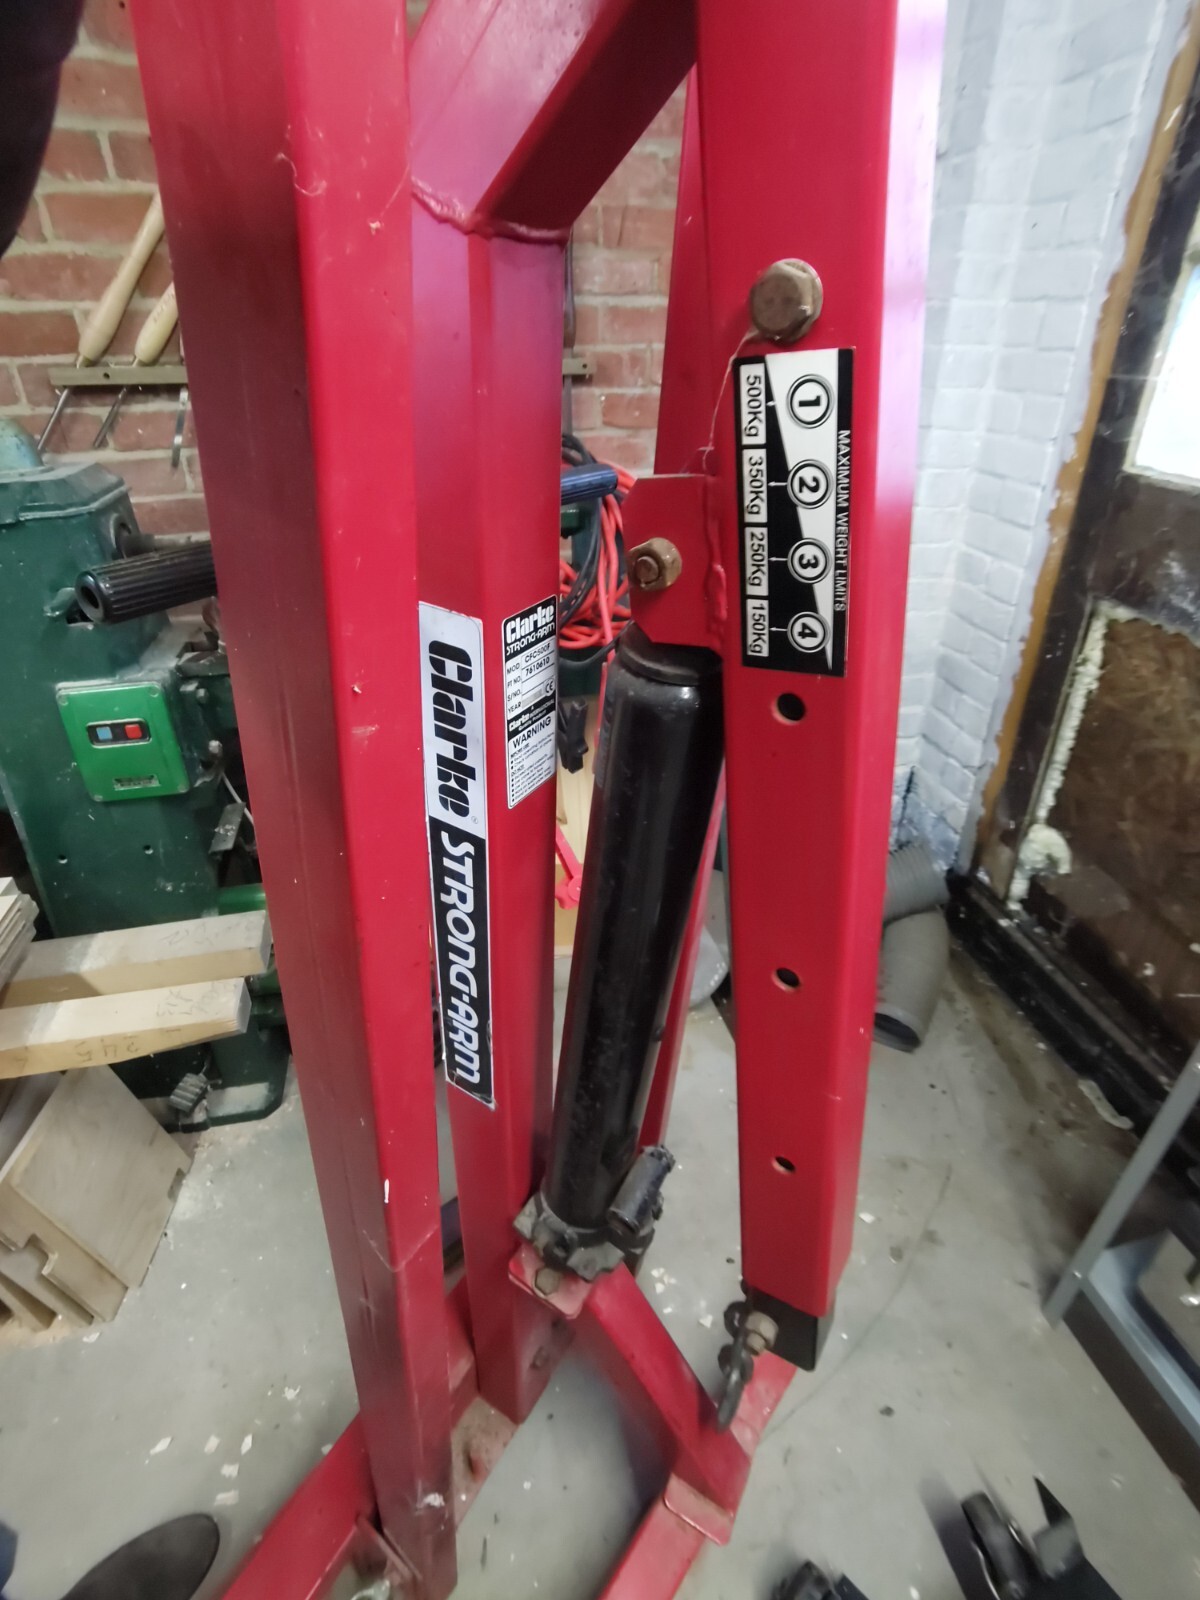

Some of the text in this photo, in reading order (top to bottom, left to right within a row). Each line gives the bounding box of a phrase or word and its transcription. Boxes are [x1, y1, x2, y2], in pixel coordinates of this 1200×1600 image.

[744, 374, 763, 438] 500Kg
[798, 395, 821, 408] 1
[746, 456, 764, 516] 350Kg
[798, 475, 820, 494] 2
[834, 430, 851, 612] MAXIMUM WEIGHT LIMITS
[748, 531, 765, 587] 250Kg
[798, 553, 820, 570] 3
[506, 605, 555, 644] Clarke
[751, 603, 765, 655] 150Kg
[797, 622, 818, 640] 4
[428, 639, 476, 818] Clarke
[512, 716, 552, 749] WARNING
